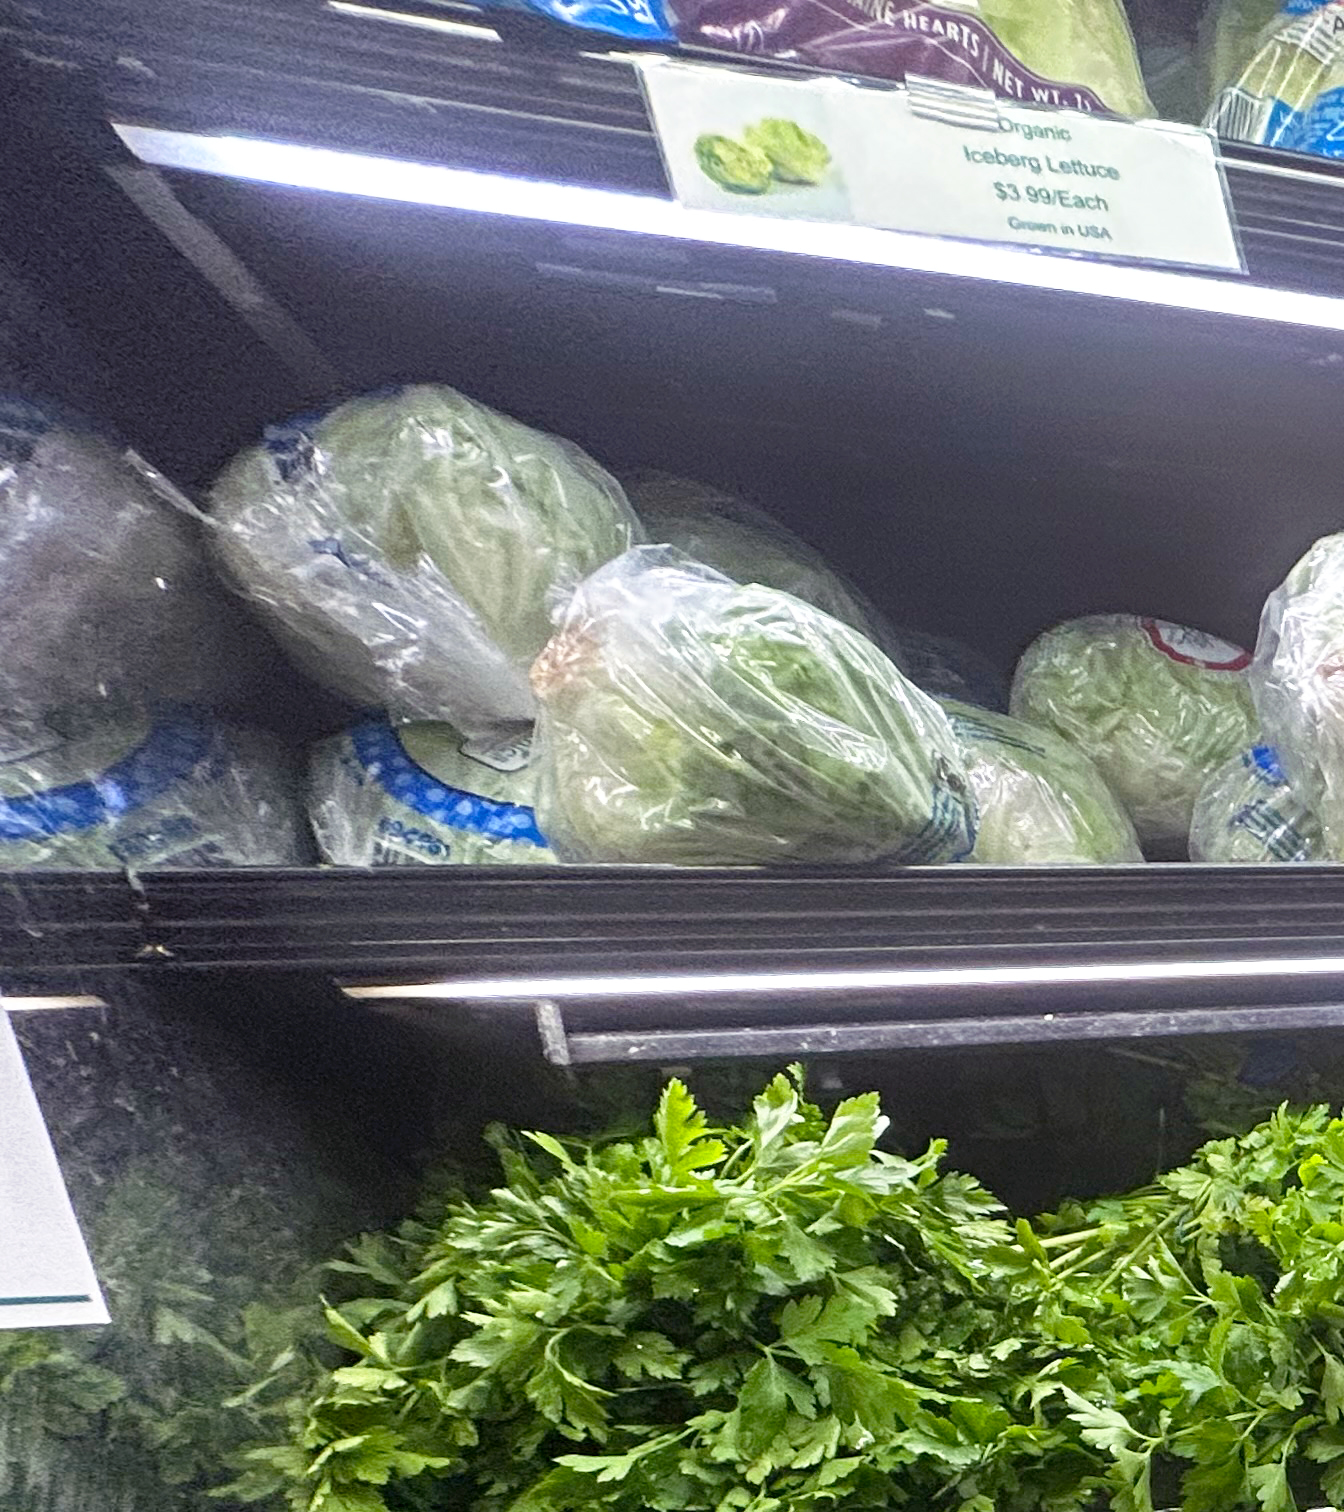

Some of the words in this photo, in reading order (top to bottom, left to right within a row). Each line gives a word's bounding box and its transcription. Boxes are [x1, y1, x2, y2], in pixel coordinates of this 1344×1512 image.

[903, 9, 980, 57] HEARTS
[992, 59, 1025, 98] NET
[999, 117, 1072, 142] Organic
[963, 145, 1043, 174] Iceberg
[1045, 154, 1121, 181] Lettuce
[1077, 223, 1113, 241] USA
